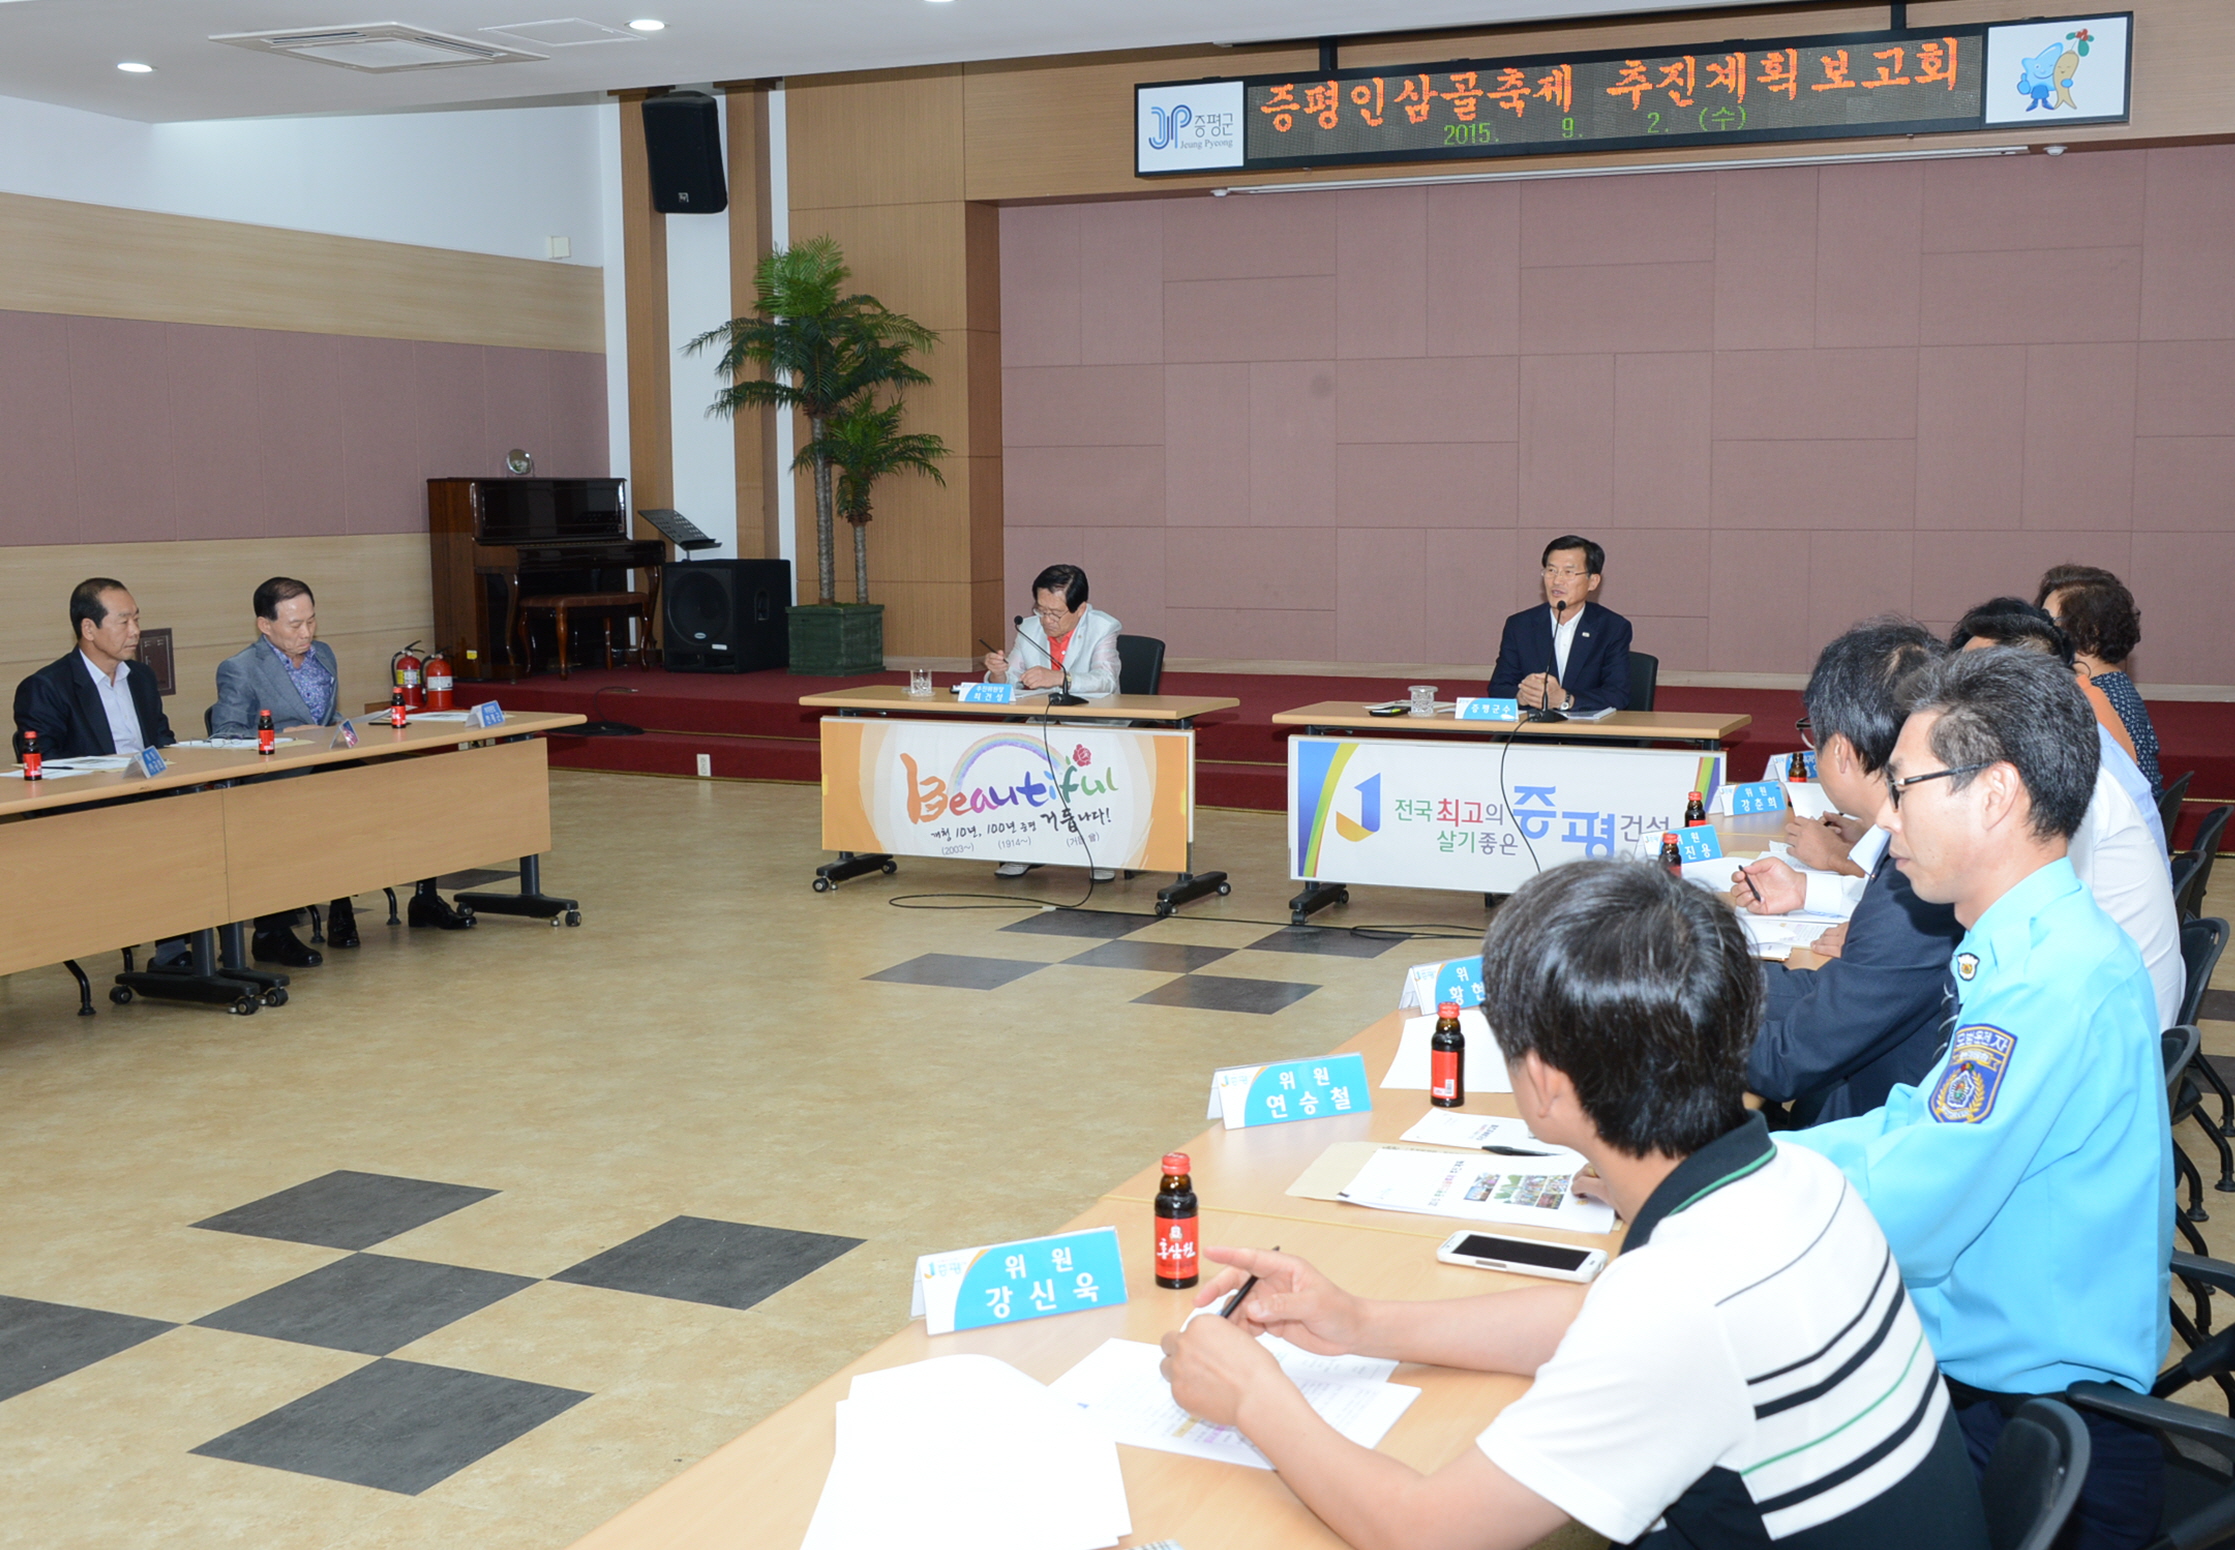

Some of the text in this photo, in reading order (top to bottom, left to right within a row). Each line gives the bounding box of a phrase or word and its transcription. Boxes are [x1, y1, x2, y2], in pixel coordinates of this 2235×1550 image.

[1261, 64, 1573, 133] 증평인삼골축제
[1194, 113, 1233, 138] 증평군
[1443, 122, 1499, 146] 2015.
[1698, 105, 1747, 131] (수)
[1180, 139, 1233, 150] Jeung Pyeong
[900, 753, 1118, 824] Beautiful
[987, 821, 1016, 835] 100년
[1020, 820, 1037, 833] 증평
[1513, 786, 1615, 860] 증평
[1156, 1237, 1197, 1260] 홍삼원
